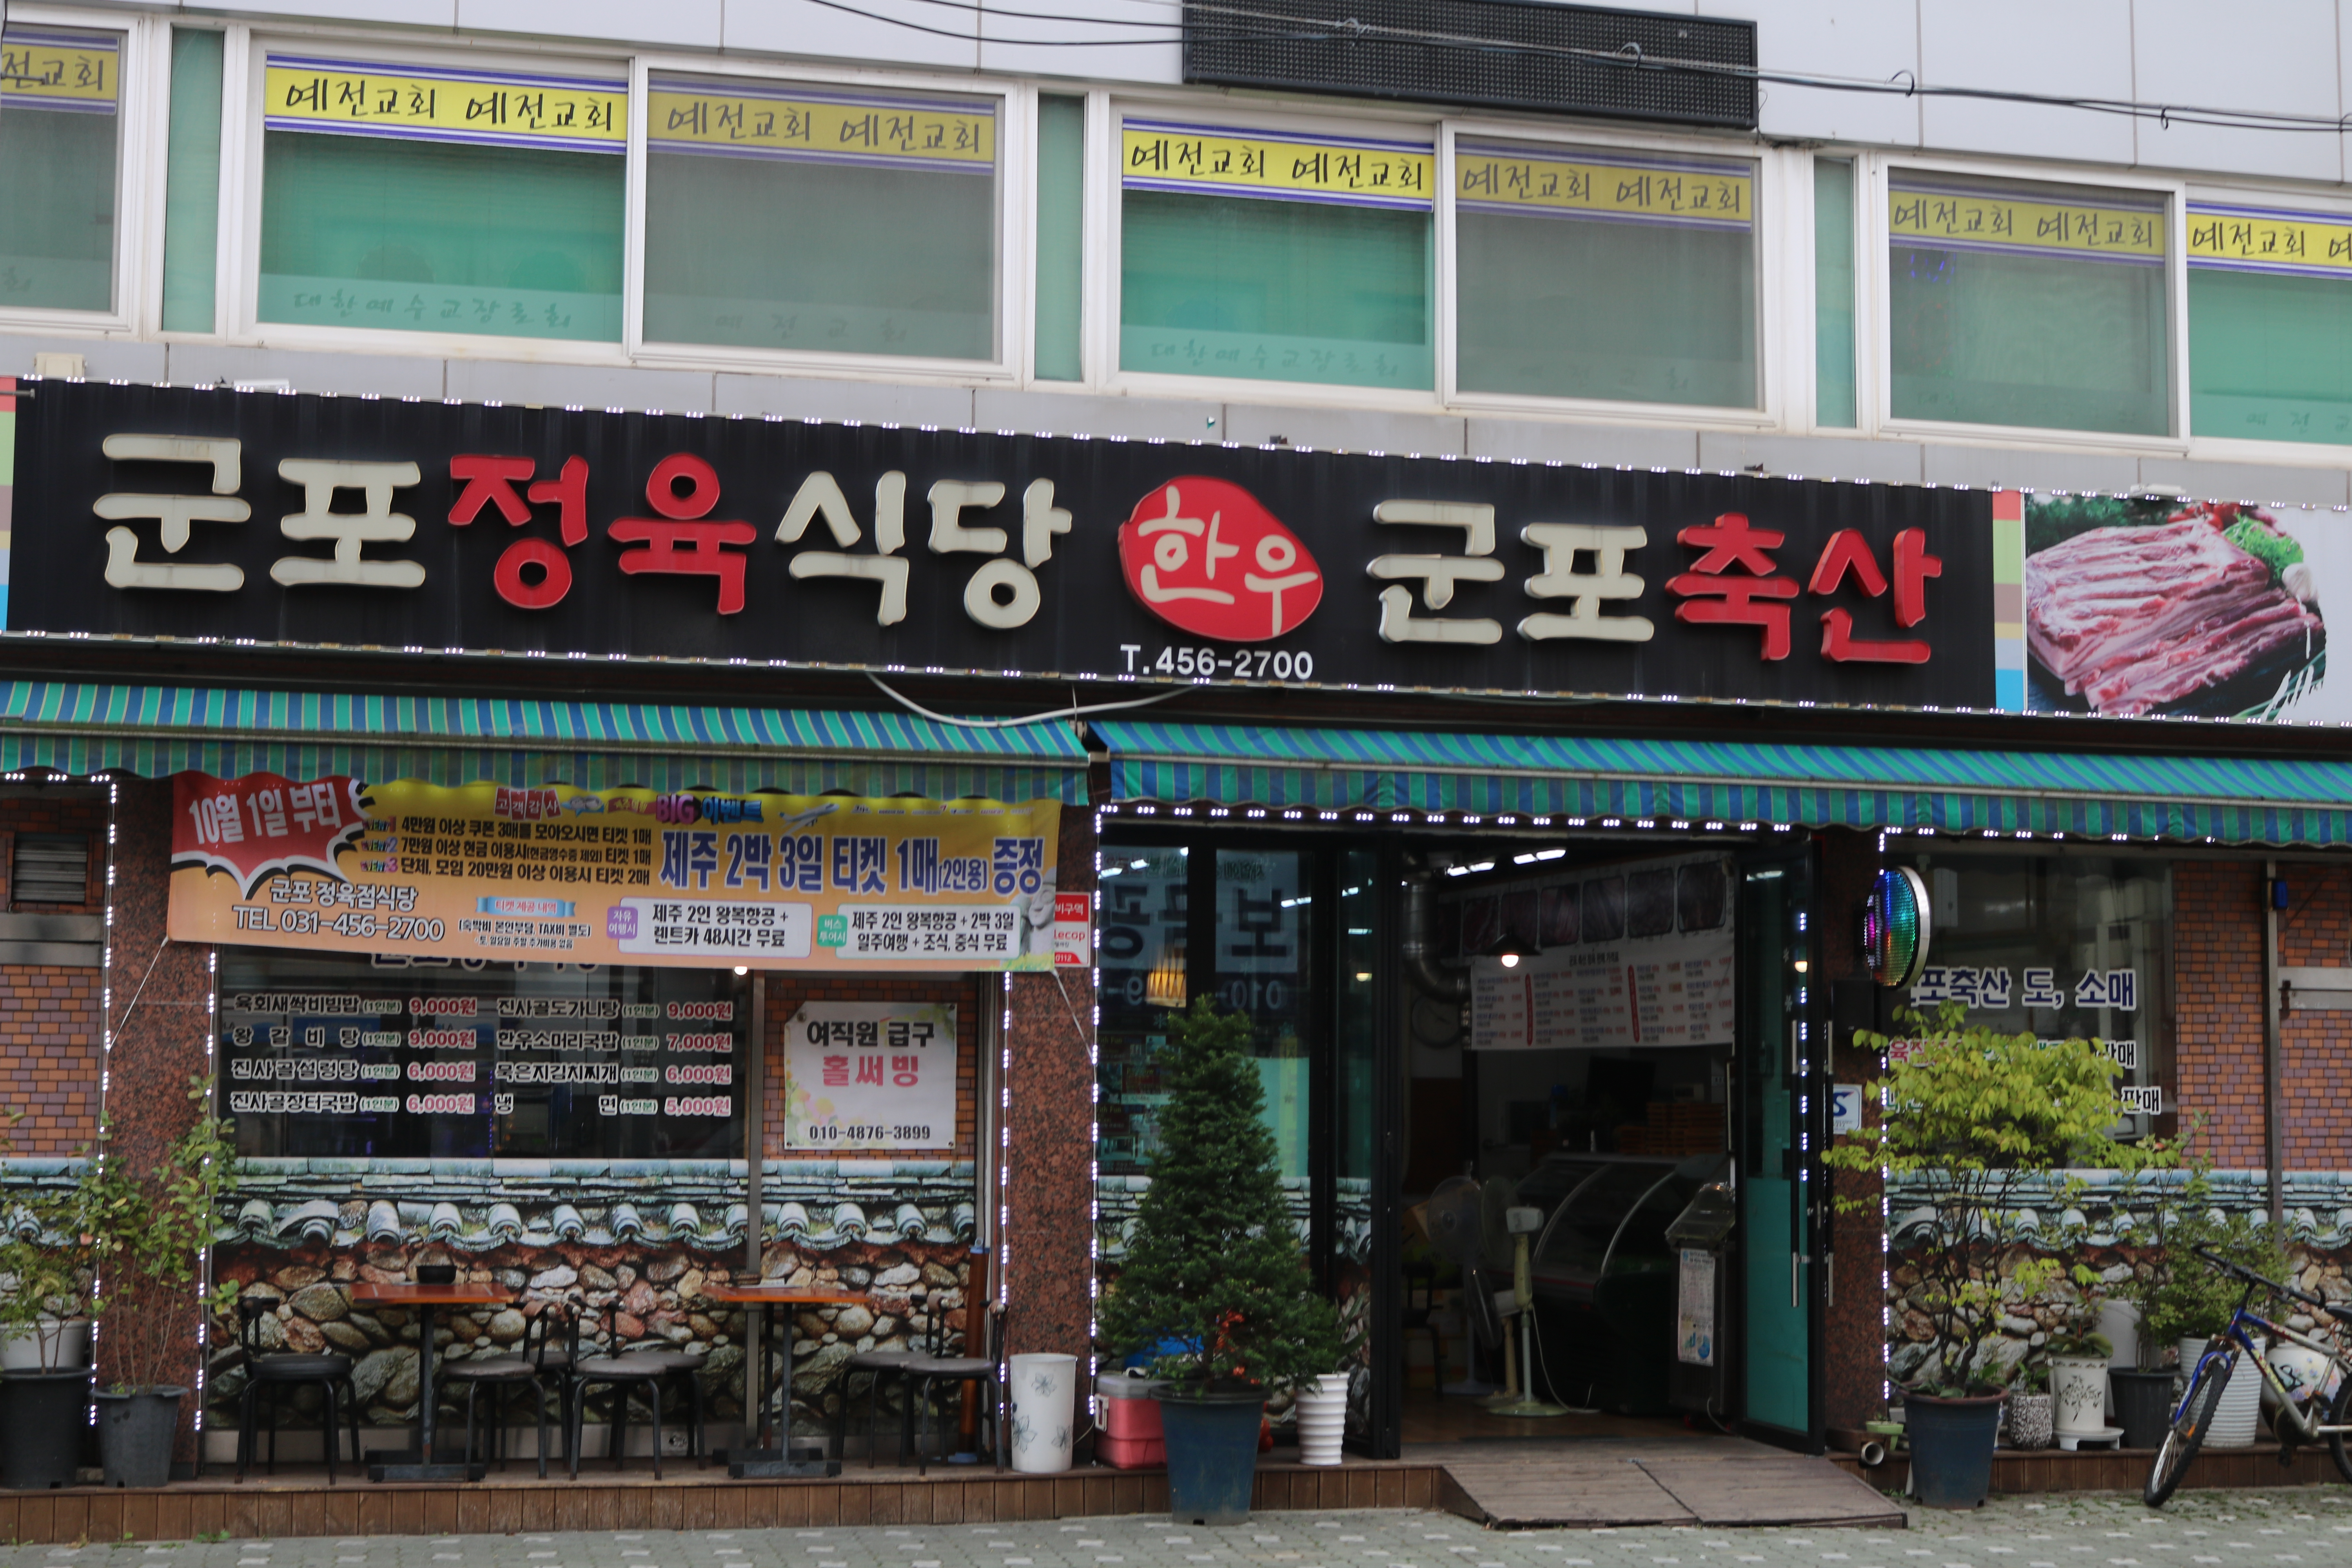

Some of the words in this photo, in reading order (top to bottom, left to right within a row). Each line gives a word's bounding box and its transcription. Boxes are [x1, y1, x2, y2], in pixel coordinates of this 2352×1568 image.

[286, 78, 435, 119] 예전교회
[466, 92, 612, 131] 예전교회
[668, 102, 810, 142] 예전교회
[840, 114, 979, 153] 예전교회
[1131, 140, 1265, 178] 예전교회
[1292, 153, 1422, 191] 예전교회
[1463, 164, 1590, 201] 예전교회
[1617, 176, 1739, 213] 예전교회
[1894, 200, 2013, 237] 예전교회
[2037, 211, 2153, 248] 예전교회
[2192, 222, 2305, 257] 예전교회
[1137, 485, 1319, 637] 한우
[1120, 643, 1313, 681] T.456-2700
[289, 782, 342, 833] 부터
[496, 797, 560, 815] 고객감사
[656, 794, 695, 824] BIG
[702, 797, 764, 824] 이벤트
[401, 816, 436, 835] 4만원
[439, 818, 466, 836] 이상
[469, 820, 495, 838] 쿠폰
[535, 824, 599, 843] 모아오시면
[603, 826, 628, 845] 티켓
[632, 828, 652, 846] 1매
[401, 836, 433, 855] 7만원
[436, 838, 461, 857] 이상
[605, 847, 629, 866] 티켓
[633, 848, 652, 866] 1매
[659, 829, 720, 891] 제주
[725, 833, 773, 891] 2박
[779, 834, 824, 893] 3일
[831, 836, 888, 896] 티켓
[992, 836, 1045, 896] 증정
[436, 858, 464, 877] 모임
[468, 861, 513, 880] 20만원
[517, 863, 546, 882] 이상
[550, 864, 592, 883] 이용시
[596, 867, 624, 886] 티켓
[628, 868, 650, 886] 2매
[270, 878, 312, 904] 군포
[316, 880, 418, 913] 정육점식당
[495, 900, 515, 913] 티켓
[516, 901, 536, 914] 제공
[537, 901, 557, 915] 내역
[232, 905, 277, 931] TEL
[280, 908, 445, 942] 031-456-2700
[613, 910, 632, 922] 자유
[652, 903, 682, 923] 제주
[687, 905, 711, 924] 2인
[852, 911, 878, 929] 제주
[882, 912, 902, 930] 2인
[971, 912, 991, 931] 2박
[995, 913, 1014, 931] 3일
[608, 922, 637, 936] 여행시
[653, 926, 699, 946] 렌트카
[703, 927, 752, 947] 48시간
[757, 929, 786, 948] 무료
[983, 934, 1008, 952] 무료
[1911, 967, 2010, 1009] 포축산
[2075, 969, 2136, 1011] 소매
[409, 997, 477, 1017] 9,000원
[667, 1001, 733, 1021] 9,000원
[408, 1029, 477, 1049] 9,000원
[496, 1029, 620, 1051] 한우소머리국밥
[666, 1032, 733, 1053] 7,000원
[807, 1021, 878, 1047] 여직원
[887, 1021, 935, 1047] 급구
[407, 1061, 475, 1082] 6,000원
[665, 1064, 732, 1085] 6,000원
[406, 1093, 475, 1114] 6,000원
[664, 1096, 731, 1116] 5,000원
[809, 1125, 931, 1140] 010-4876-3899
